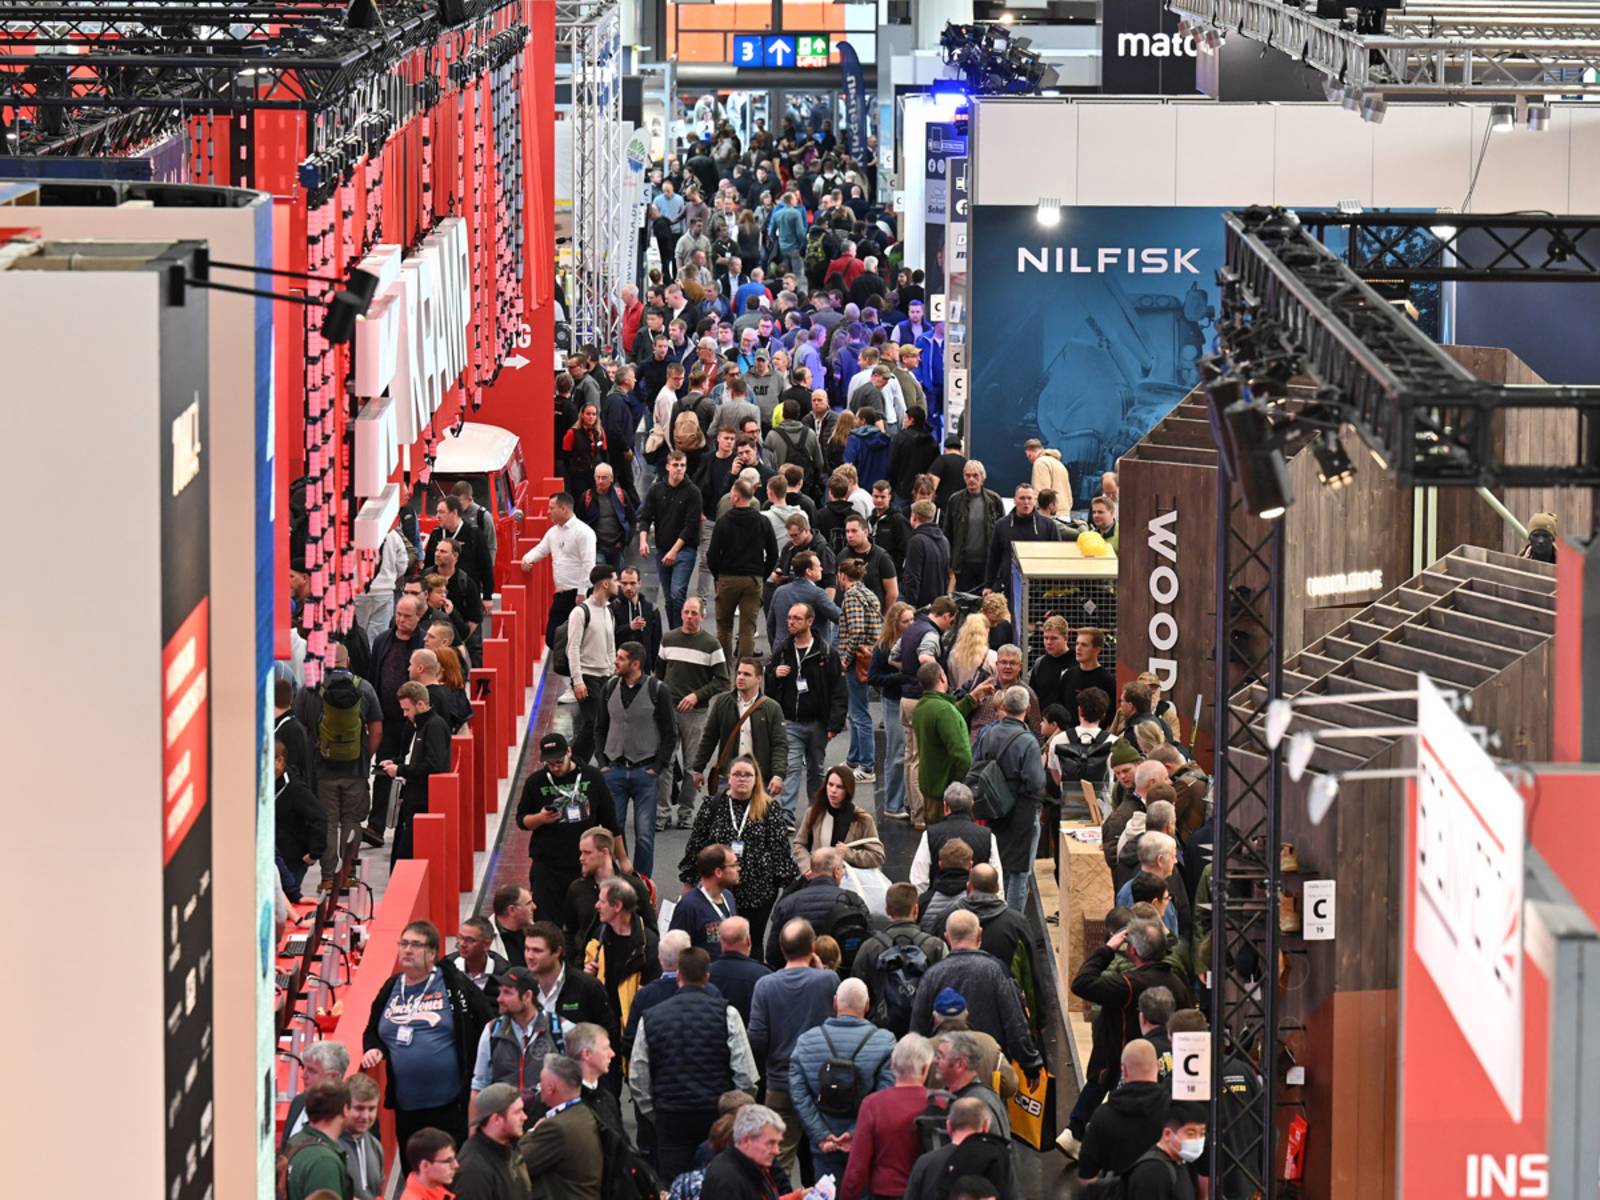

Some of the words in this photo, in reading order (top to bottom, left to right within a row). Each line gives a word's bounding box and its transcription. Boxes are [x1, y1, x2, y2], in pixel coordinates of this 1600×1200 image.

[742, 42, 754, 61] 3
[1018, 247, 1200, 274] NILFISK
[935, 302, 942, 312] C
[953, 353, 961, 363] C
[955, 378, 963, 389] C
[1313, 899, 1327, 919] C
[1184, 1054, 1199, 1076] C
[1466, 1153, 1550, 1198] INS
